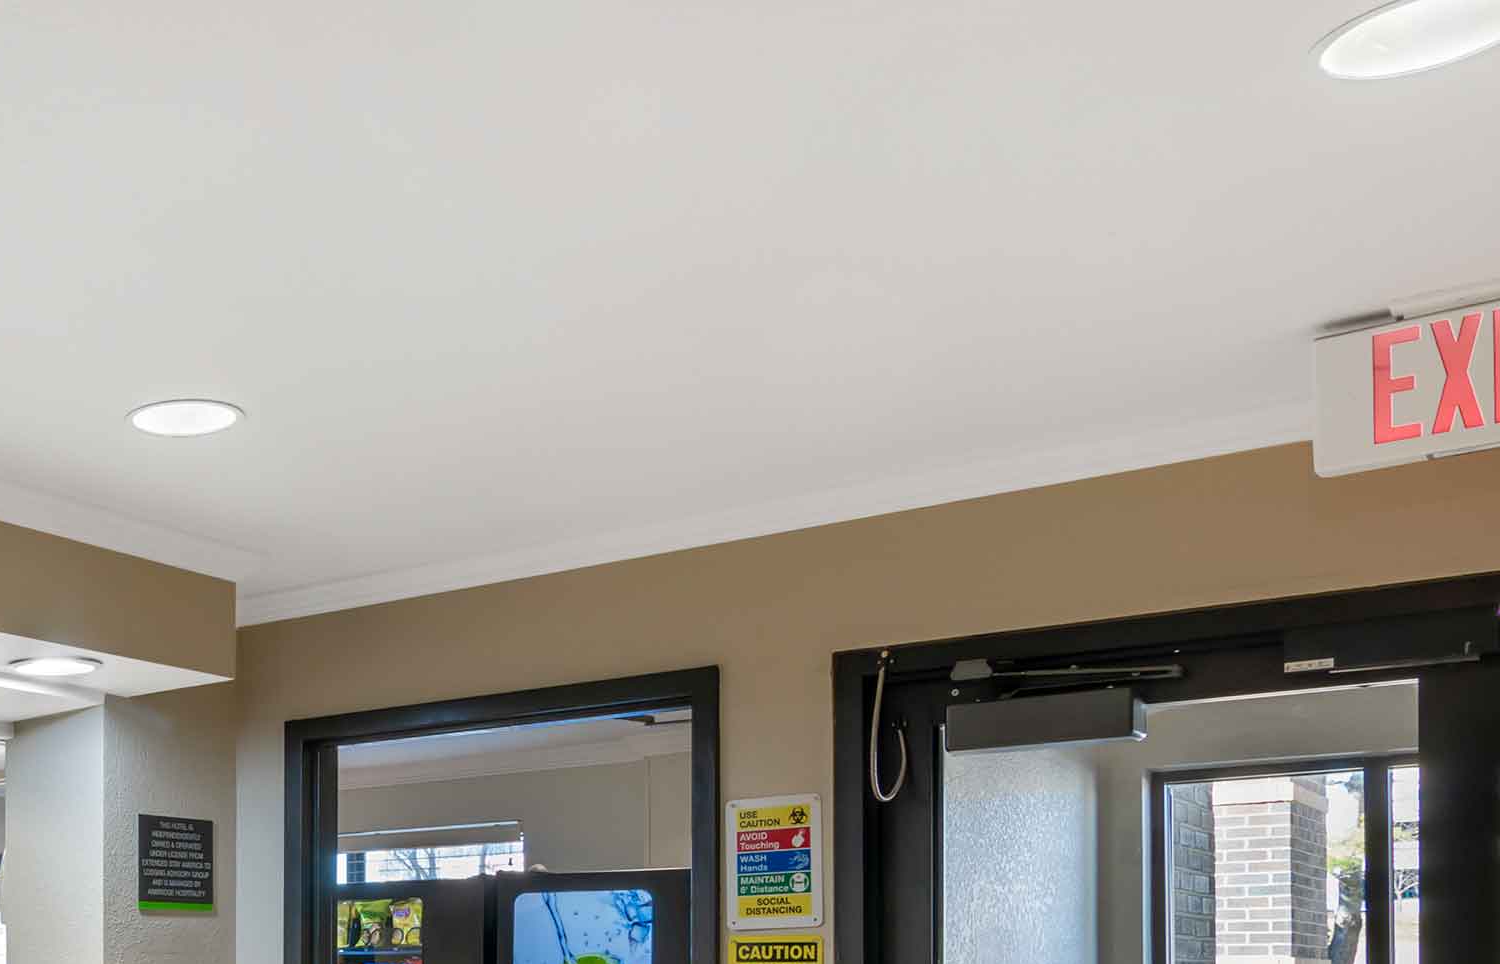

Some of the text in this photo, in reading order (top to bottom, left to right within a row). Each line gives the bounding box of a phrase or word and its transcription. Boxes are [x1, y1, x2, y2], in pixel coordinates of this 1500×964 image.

[740, 811, 757, 819] USE
[740, 818, 780, 828] CAUTION
[740, 832, 768, 841] AVOID
[740, 840, 780, 850] Touching
[740, 855, 767, 863] WASH
[740, 864, 768, 872] Hands
[740, 875, 785, 885] MAINTAIN
[750, 885, 789, 894] Distance
[756, 897, 791, 906] SOCIAL
[746, 905, 802, 916] DISTANCING
[738, 944, 816, 960] CAUTION
